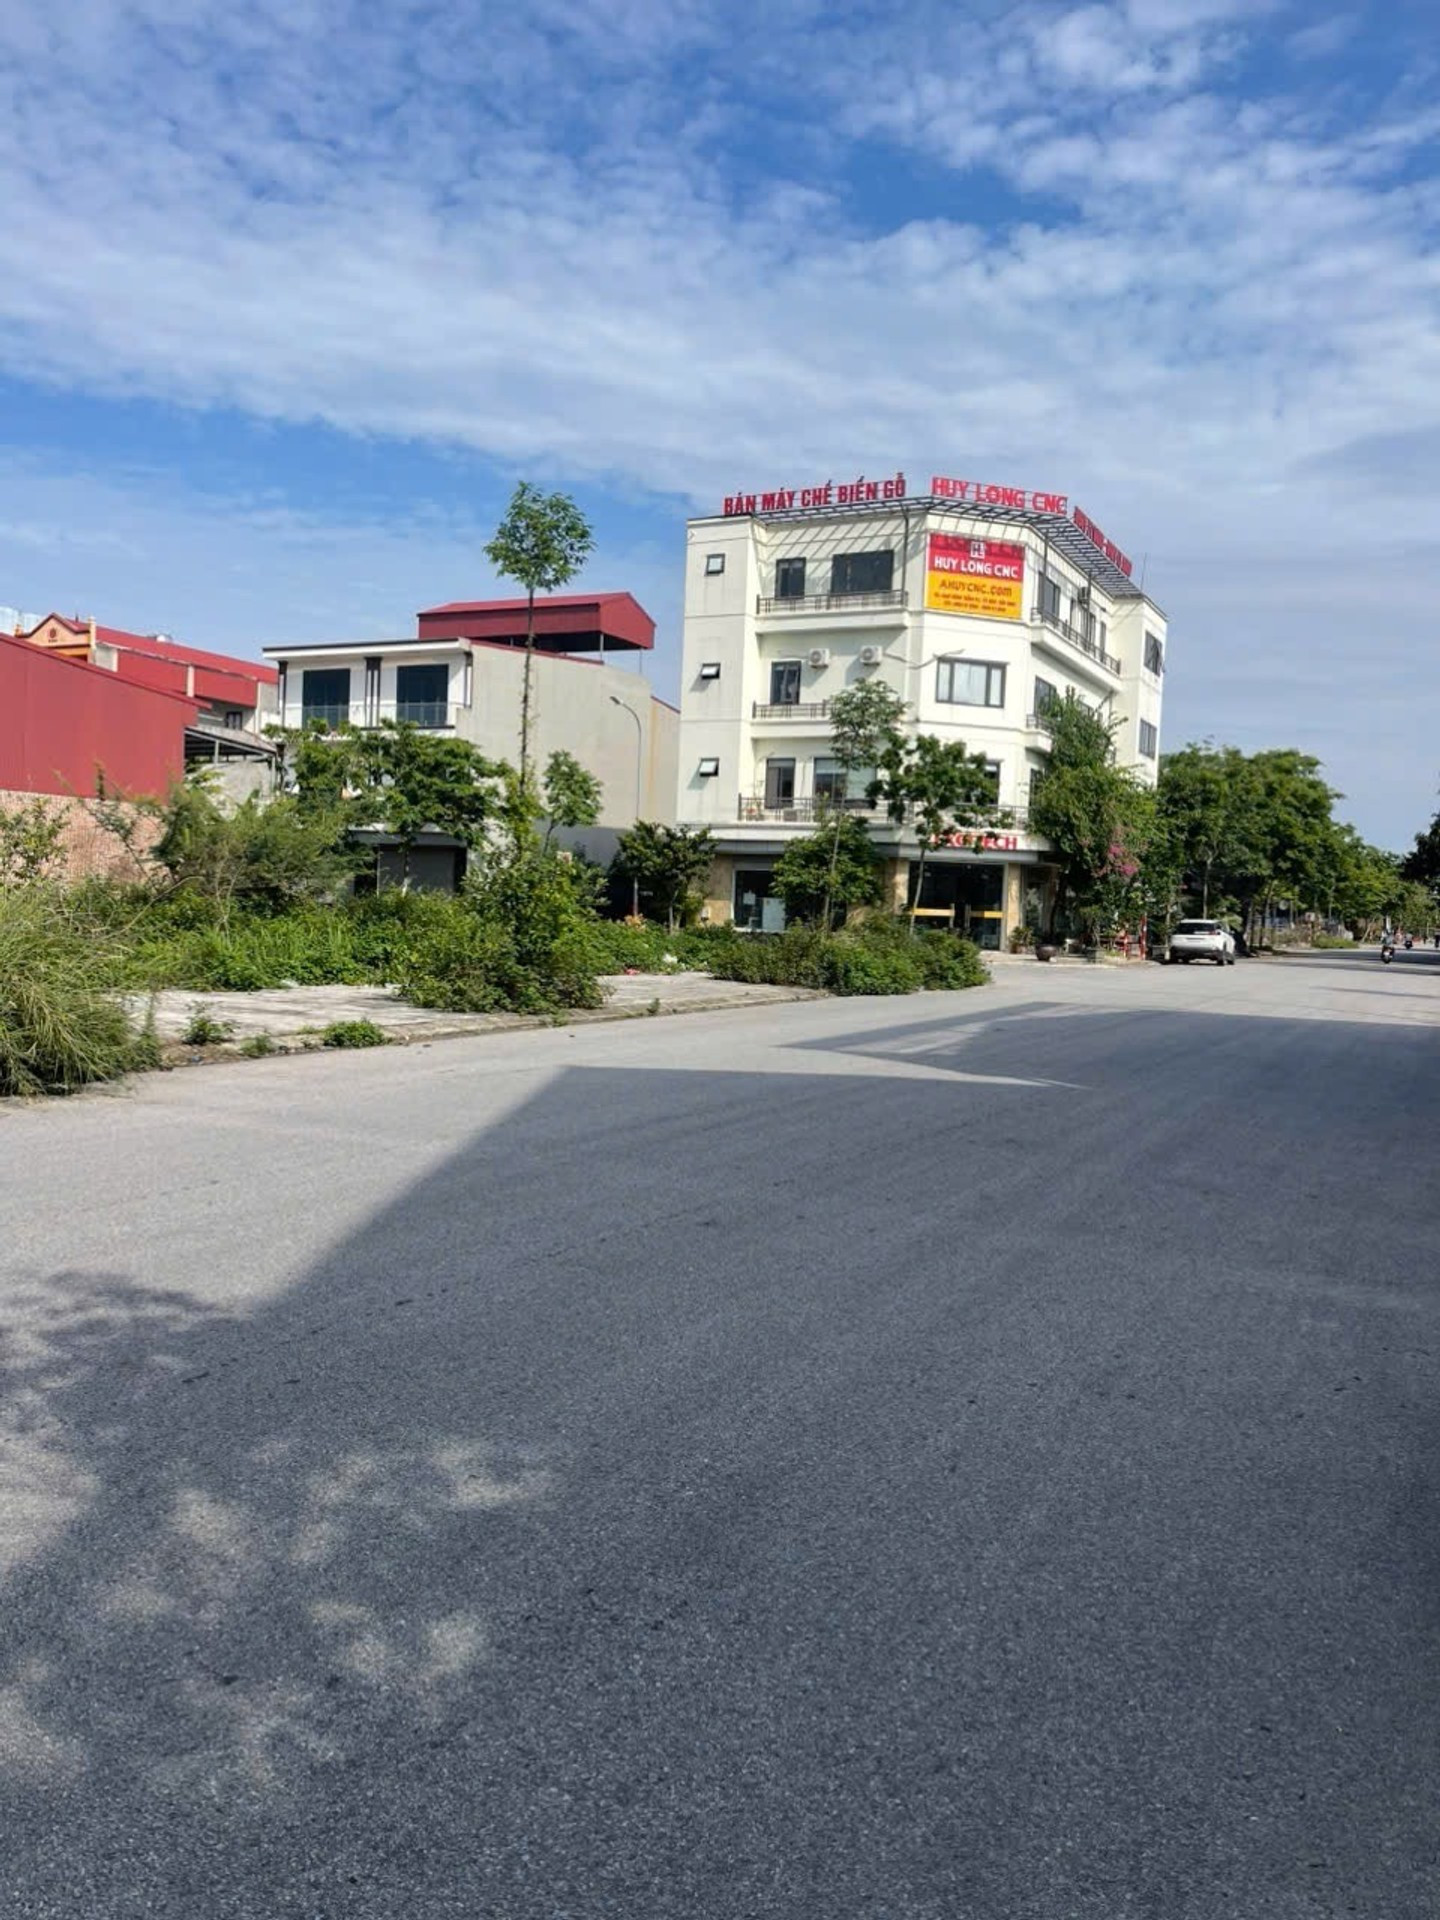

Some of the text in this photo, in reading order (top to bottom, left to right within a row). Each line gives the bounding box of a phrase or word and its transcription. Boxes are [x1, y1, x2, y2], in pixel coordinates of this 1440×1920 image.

[724, 491, 757, 516] BÁN
[761, 487, 795, 511] MÁY
[801, 479, 832, 507] CHẾ
[838, 475, 877, 504] BIẾN
[931, 476, 1068, 516] HUY LONG CNC
[934, 555, 1019, 579] HUY LONG CNC
